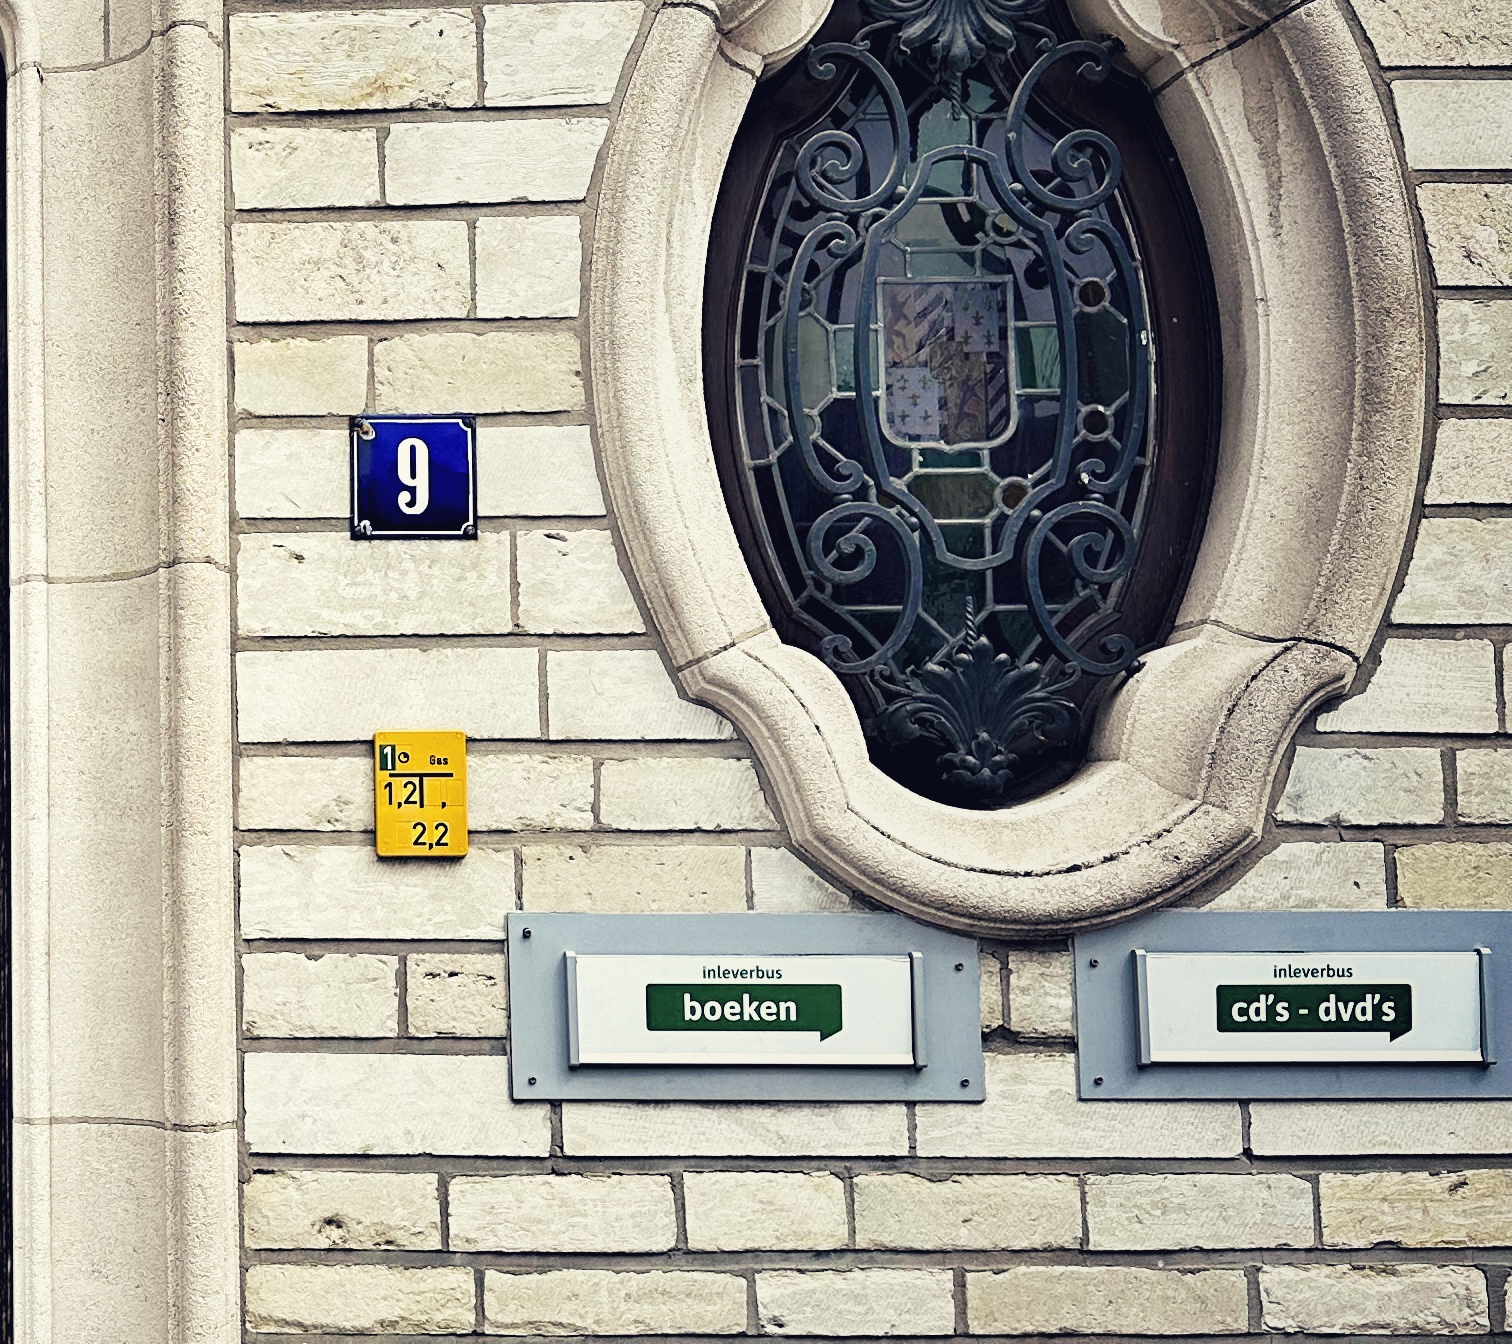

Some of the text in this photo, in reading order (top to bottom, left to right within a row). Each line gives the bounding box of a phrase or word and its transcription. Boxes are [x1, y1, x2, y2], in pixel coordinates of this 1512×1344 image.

[397, 437, 429, 515] 9
[383, 745, 393, 770] 1
[384, 780, 418, 810] 1,2
[412, 821, 449, 851] 2,2
[702, 965, 783, 980] inleverbus
[1273, 964, 1353, 979] inleverbus
[683, 993, 797, 1022] boeken
